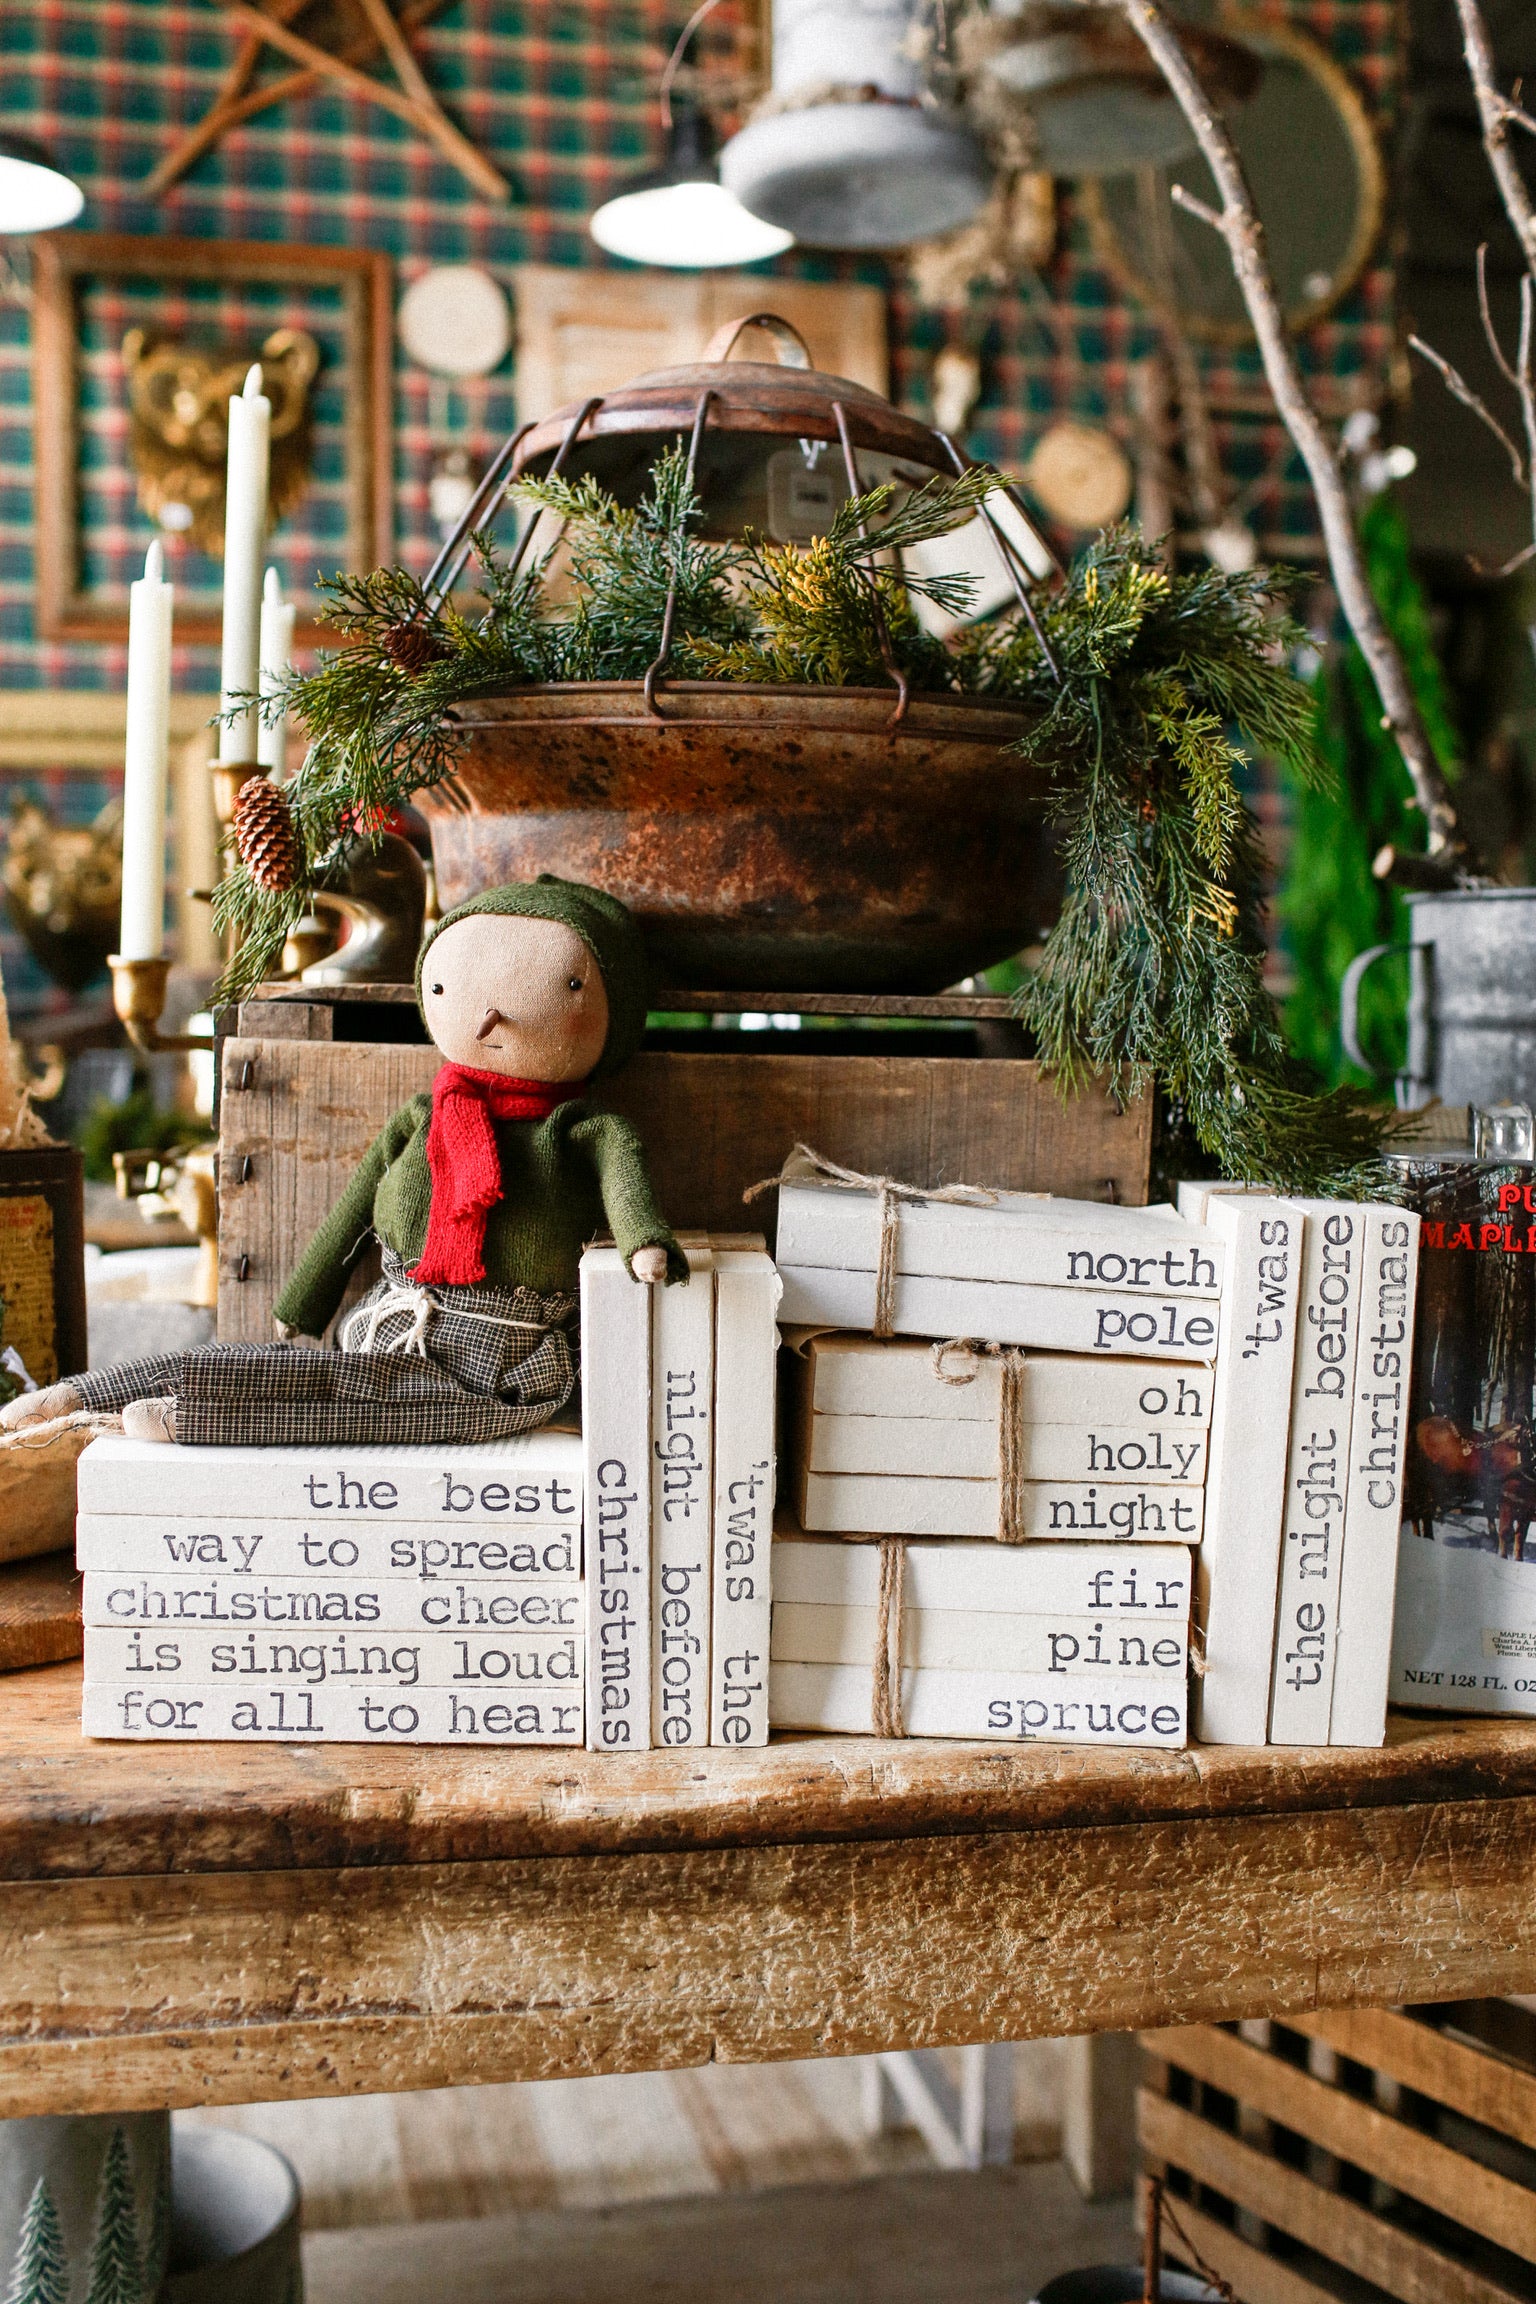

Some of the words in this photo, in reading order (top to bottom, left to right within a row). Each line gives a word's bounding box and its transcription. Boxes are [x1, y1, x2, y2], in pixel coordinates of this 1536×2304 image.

[1066, 1248, 1217, 1290] north
[1093, 1306, 1215, 1348] pole
[1306, 1215, 1354, 1399] before
[1361, 1221, 1409, 1509] christmas
[1139, 1379, 1202, 1417] oh
[655, 1370, 706, 1522] night
[1088, 1432, 1200, 1478] holy
[303, 1471, 398, 1510] the
[442, 1473, 575, 1514] best
[1050, 1488, 1196, 1539] night
[1290, 1429, 1342, 1580] night
[164, 1535, 262, 1574] way
[298, 1533, 359, 1567] to
[391, 1534, 575, 1578] spread
[107, 1581, 380, 1621] christmas
[421, 1586, 579, 1627] cheer
[594, 1459, 641, 1746] christmas
[1088, 1568, 1183, 1608] fir
[126, 1632, 181, 1675] is
[212, 1635, 422, 1684] singing
[453, 1640, 579, 1679] loud
[660, 1564, 701, 1745] before
[1048, 1623, 1181, 1672] pine
[1286, 1603, 1325, 1691] the
[722, 1651, 763, 1743] the
[1404, 1670, 1444, 1686] NET
[1450, 1674, 1477, 1688] 128
[1482, 1676, 1508, 1690] FL.
[118, 1691, 203, 1732] for
[232, 1692, 323, 1731] all
[358, 1694, 419, 1733] to
[449, 1695, 580, 1734] hear
[987, 1700, 1181, 1738] spruce
